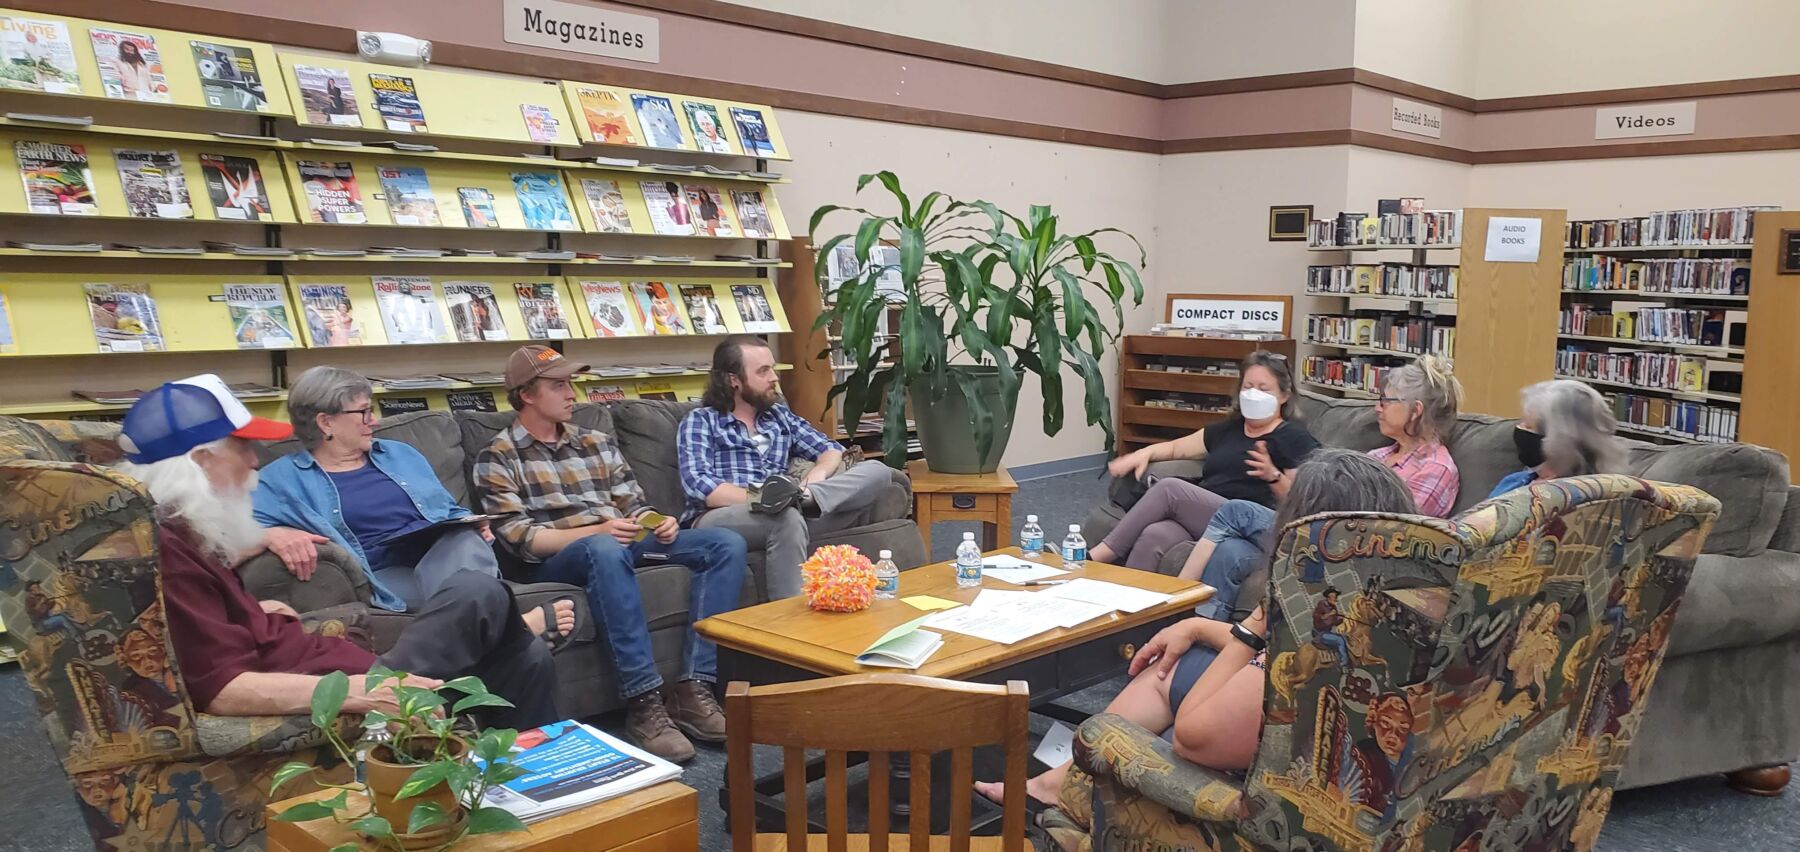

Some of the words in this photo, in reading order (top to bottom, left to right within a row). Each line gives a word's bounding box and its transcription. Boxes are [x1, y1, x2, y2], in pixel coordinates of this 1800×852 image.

[523, 8, 645, 49] Magazines
[651, 100, 673, 114] SKI
[1394, 107, 1421, 125] Recorded
[1423, 114, 1440, 129] Books
[1616, 115, 1675, 129] Videos
[316, 189, 351, 199] HIDDEN
[321, 197, 349, 206] SUPER
[318, 204, 357, 213] POWERS
[1503, 225, 1526, 233] AUDIO
[1501, 237, 1526, 245] BOOKS
[444, 286, 491, 297] RUNNER'S
[226, 294, 282, 302] REPUBLIC
[1177, 309, 1235, 320] COMPACT
[1242, 310, 1279, 321] DISCS
